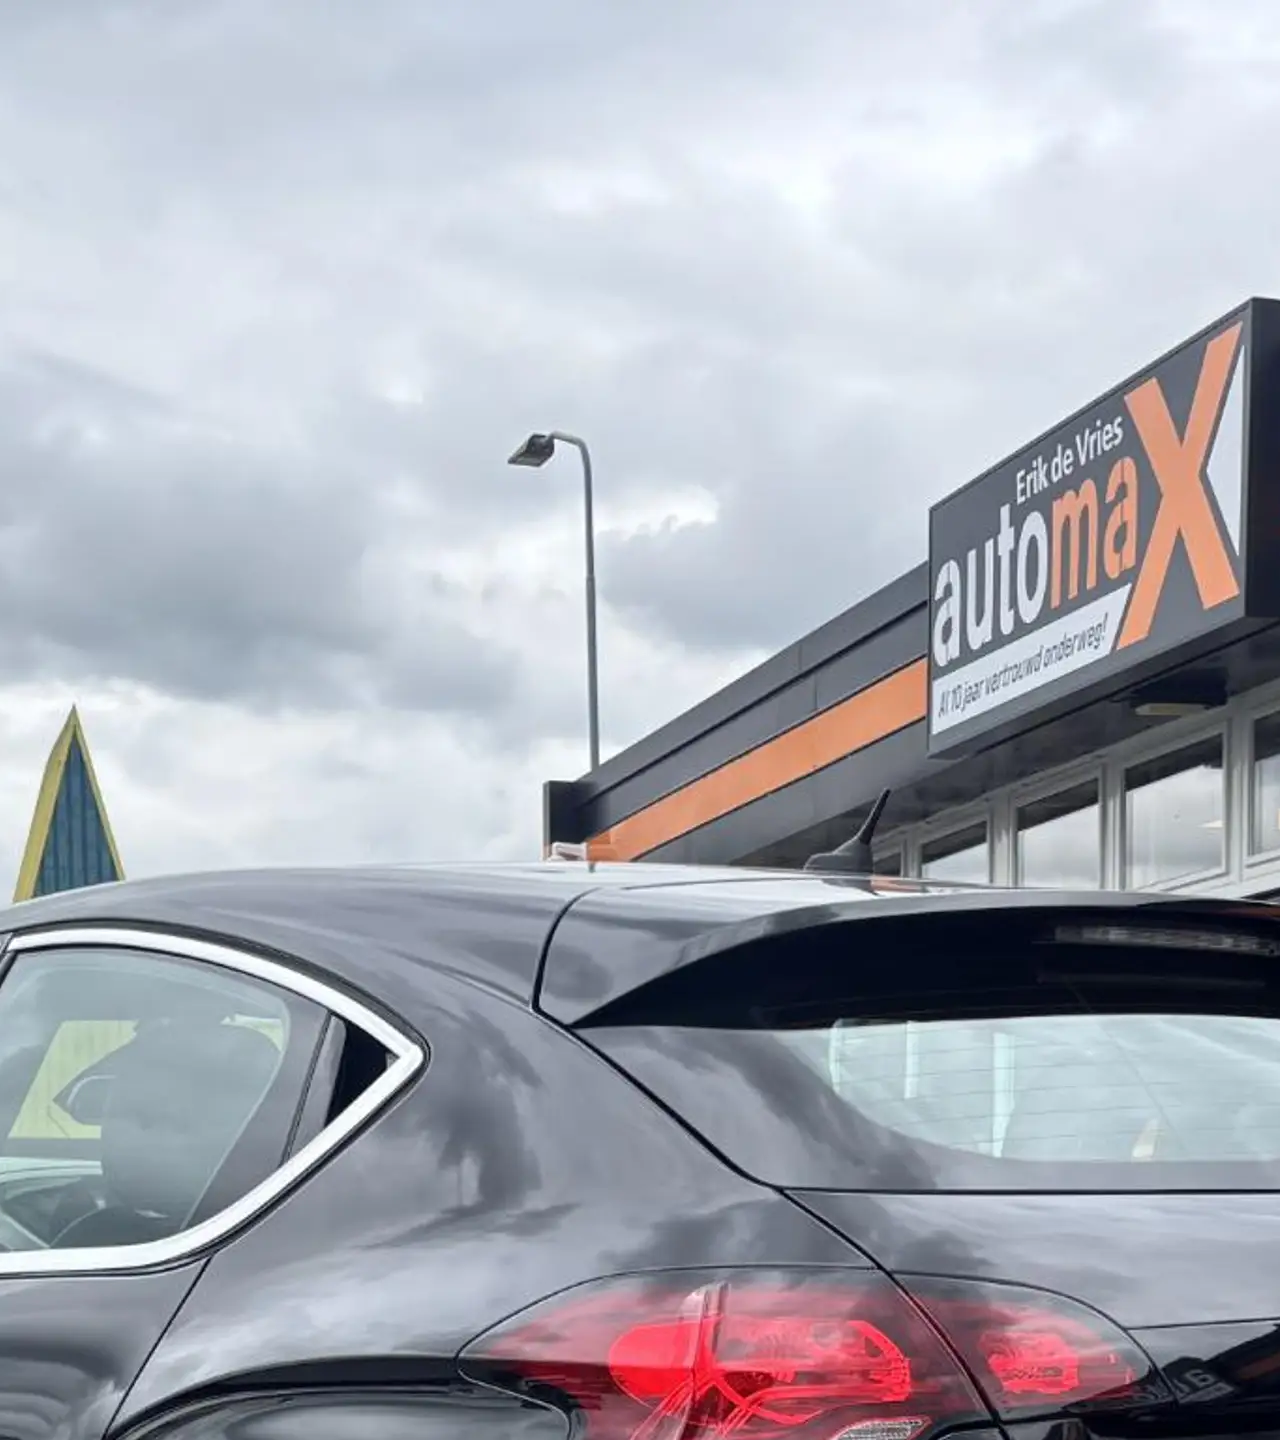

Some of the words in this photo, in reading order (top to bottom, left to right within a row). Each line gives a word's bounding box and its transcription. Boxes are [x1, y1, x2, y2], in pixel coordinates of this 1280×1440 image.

[1016, 463, 1049, 505] Erik
[1051, 443, 1074, 478] de
[1076, 416, 1124, 468] Vries
[938, 686, 949, 718] Al
[961, 680, 985, 713] jaar
[985, 644, 1045, 696] vertrouwd
[1044, 612, 1109, 668] onderweg!
